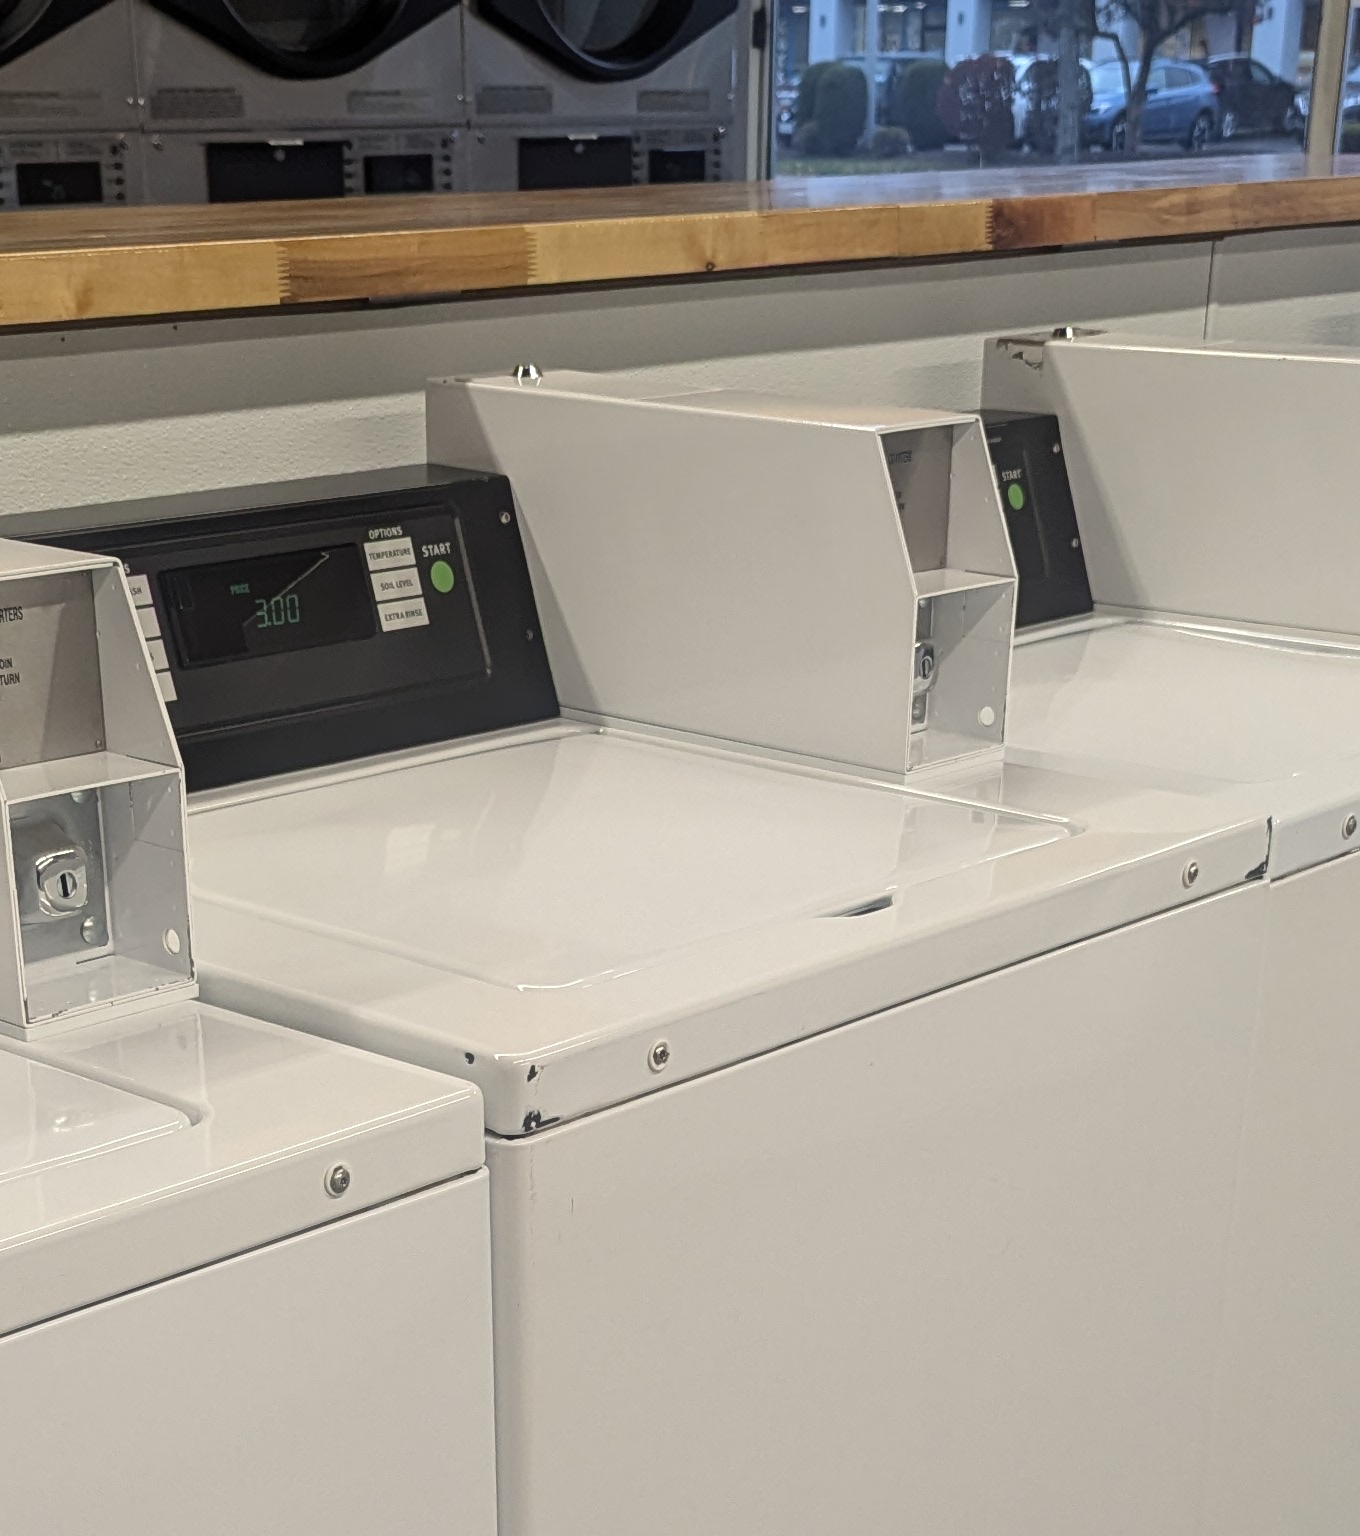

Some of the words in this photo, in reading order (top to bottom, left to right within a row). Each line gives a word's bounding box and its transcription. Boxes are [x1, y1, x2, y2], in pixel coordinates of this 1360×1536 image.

[1001, 469, 1022, 482] START
[368, 526, 403, 540] OPTIONS
[369, 547, 412, 561] TEMPERATURE
[422, 542, 451, 558] START
[380, 581, 395, 591] SOIL
[395, 579, 414, 589] LEVEL
[255, 594, 300, 628] 3.00
[384, 611, 405, 622] EXTRA
[405, 608, 423, 619] RINSE
